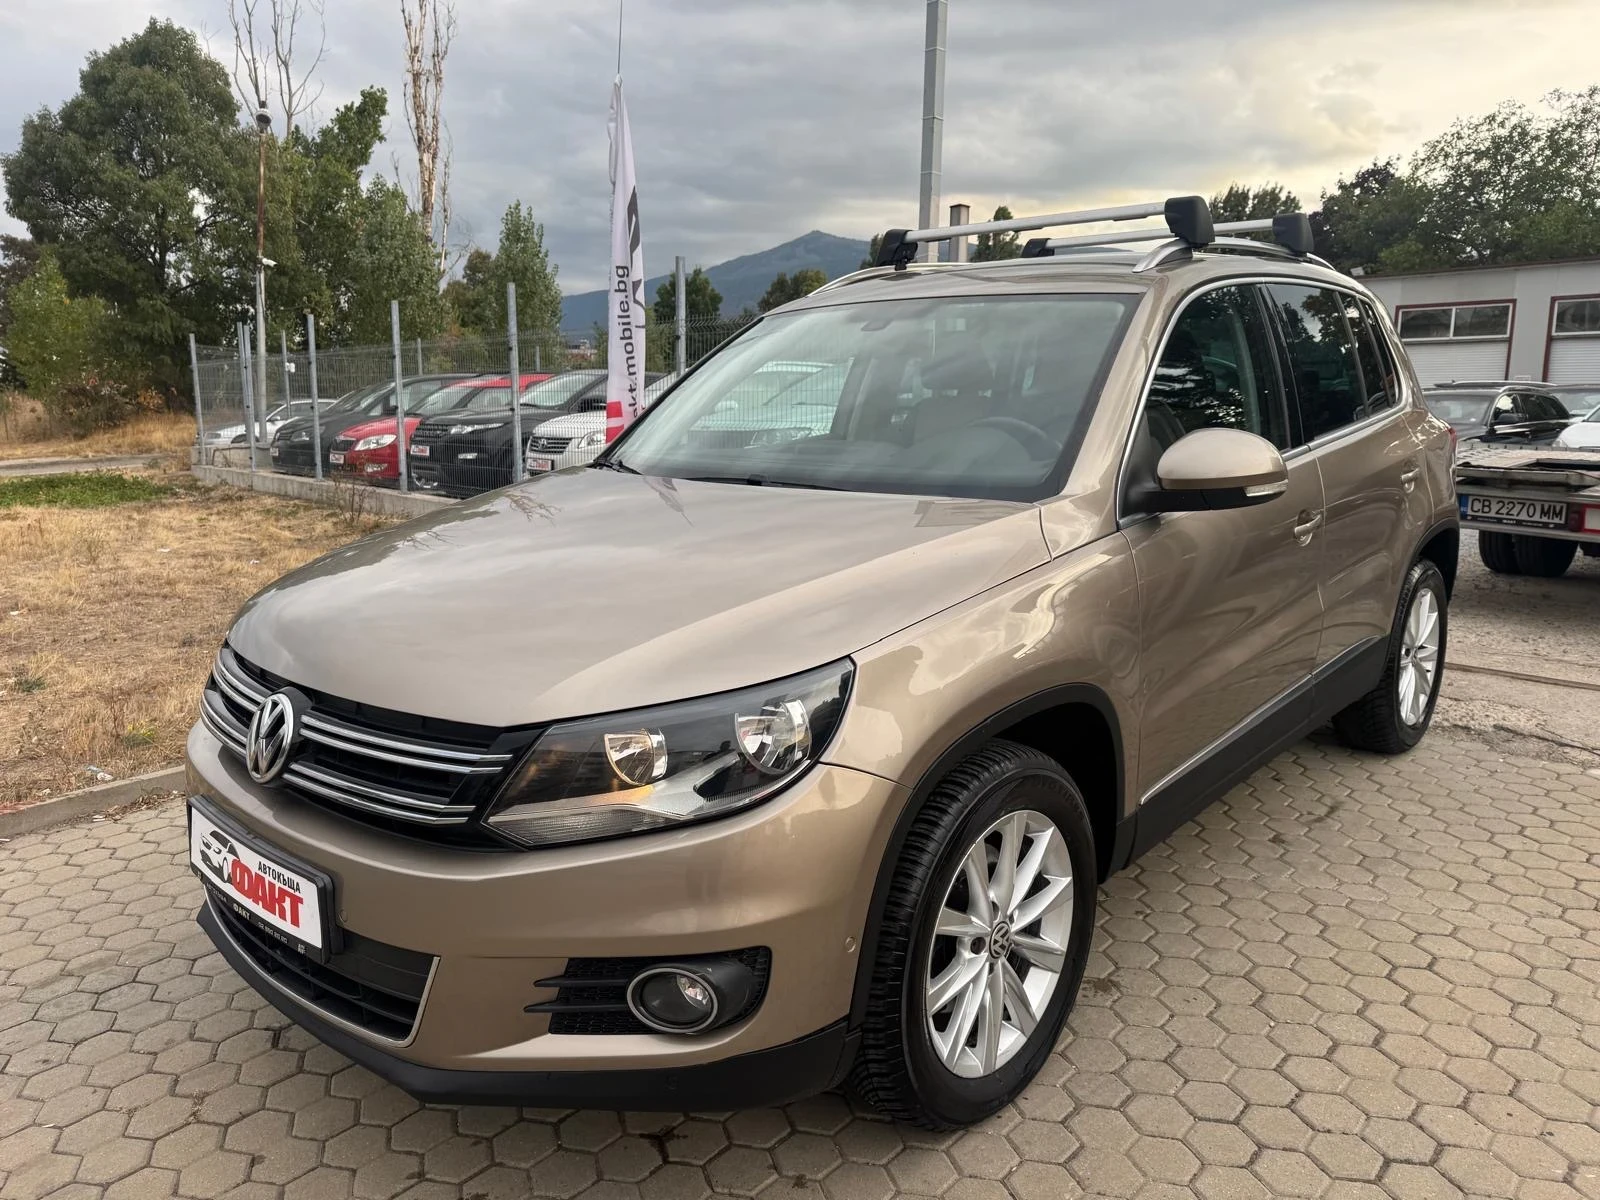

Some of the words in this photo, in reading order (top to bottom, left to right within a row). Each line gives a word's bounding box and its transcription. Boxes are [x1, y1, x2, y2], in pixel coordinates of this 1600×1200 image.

[1470, 498, 1492, 514] CB
[1495, 501, 1537, 518] 2270
[1540, 503, 1564, 520] MM
[231, 858, 304, 928] ФАКТ
[257, 861, 301, 893] АВТОКЪЩА
